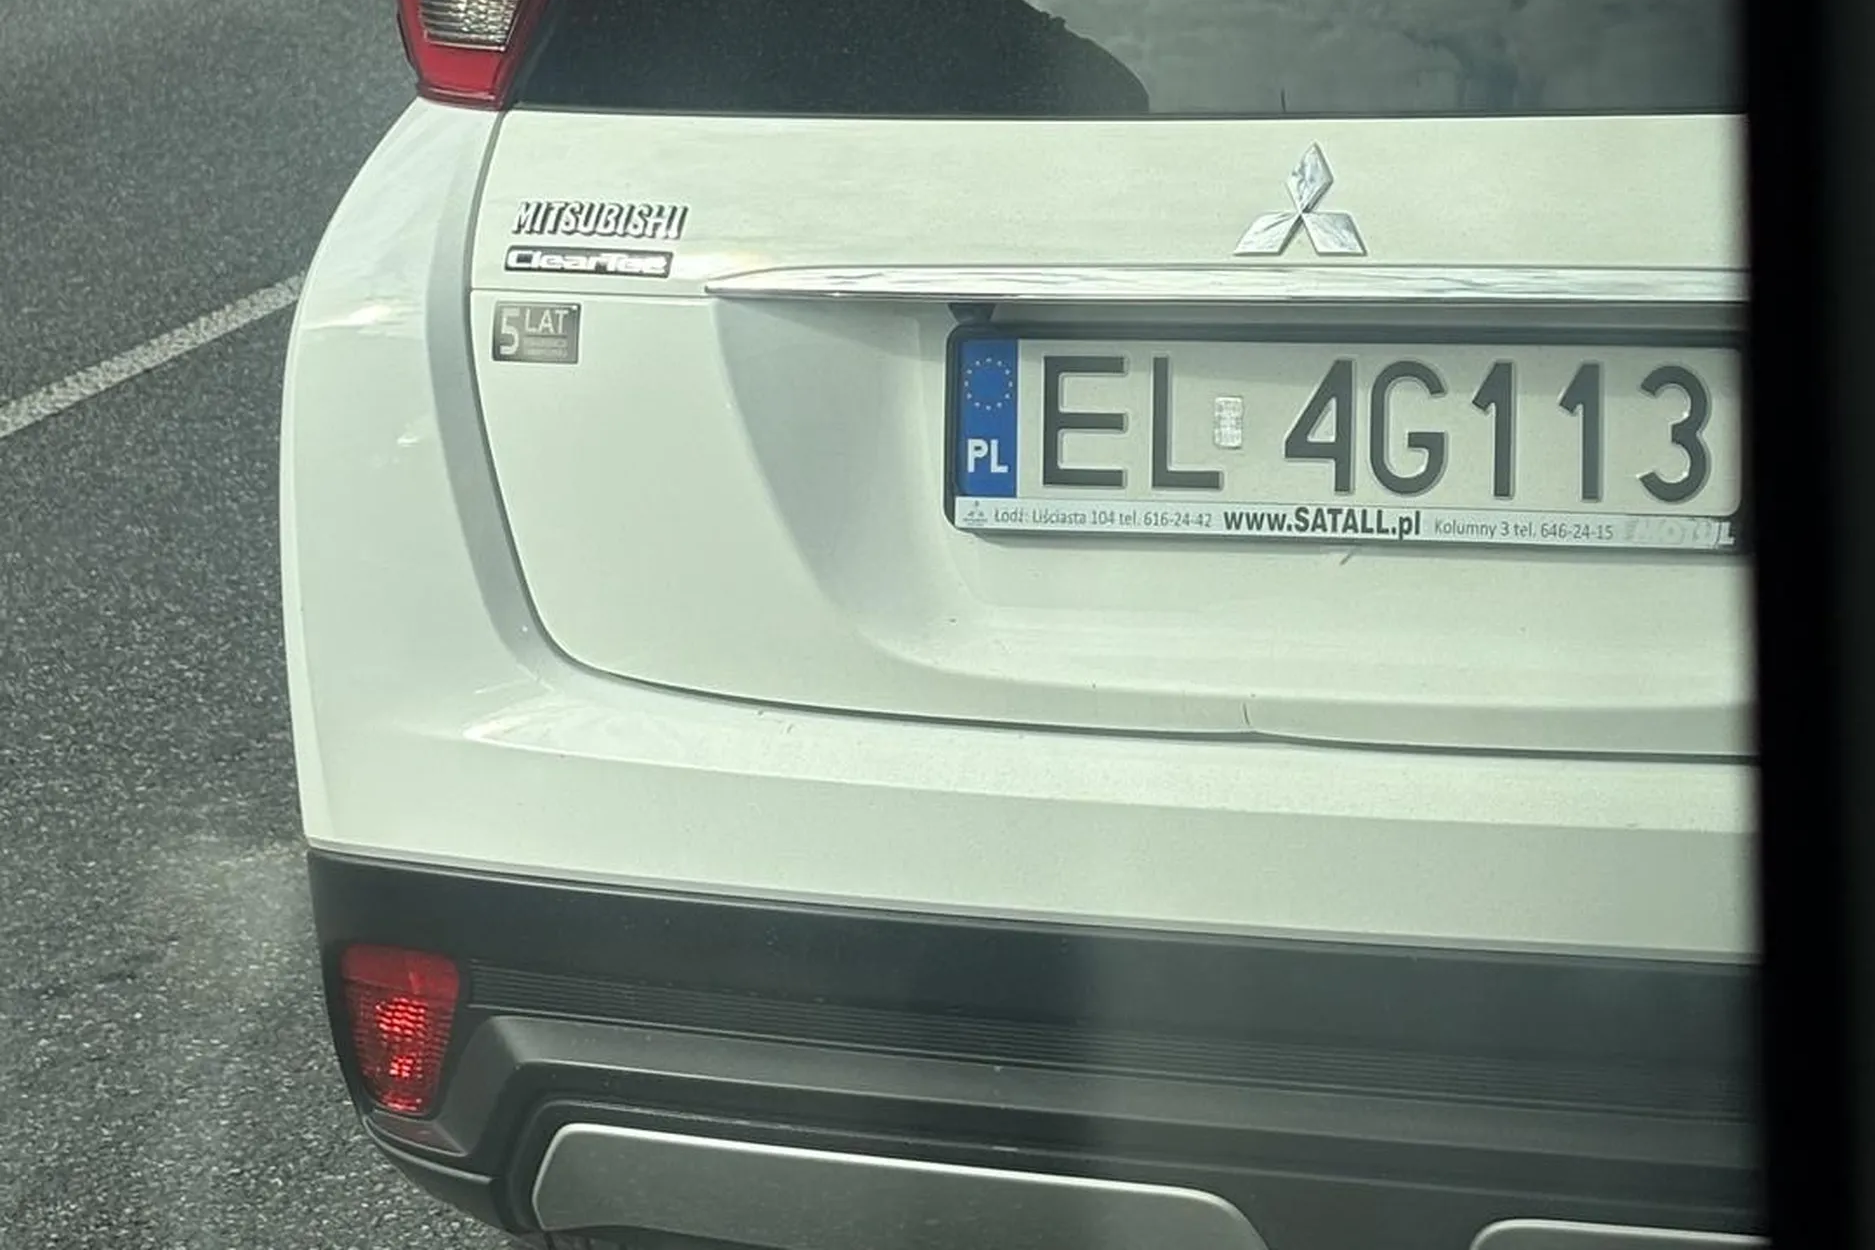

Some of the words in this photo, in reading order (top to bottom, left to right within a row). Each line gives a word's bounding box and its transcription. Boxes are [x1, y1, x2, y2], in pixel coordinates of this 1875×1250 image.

[512, 201, 689, 240] MITSUBISHI
[499, 307, 520, 355] 5
[524, 308, 570, 334] LAT
[1043, 356, 1223, 488] EL
[1283, 358, 1711, 504] 4G113
[967, 439, 1009, 473] PL
[1091, 509, 1115, 525] 104
[1143, 511, 1213, 529] 616-24-42
[1223, 506, 1422, 541] www.SATALL.pl
[1434, 516, 1498, 538] Kolumny
[1500, 520, 1511, 538] 3
[1540, 522, 1614, 540] 646-24-15
